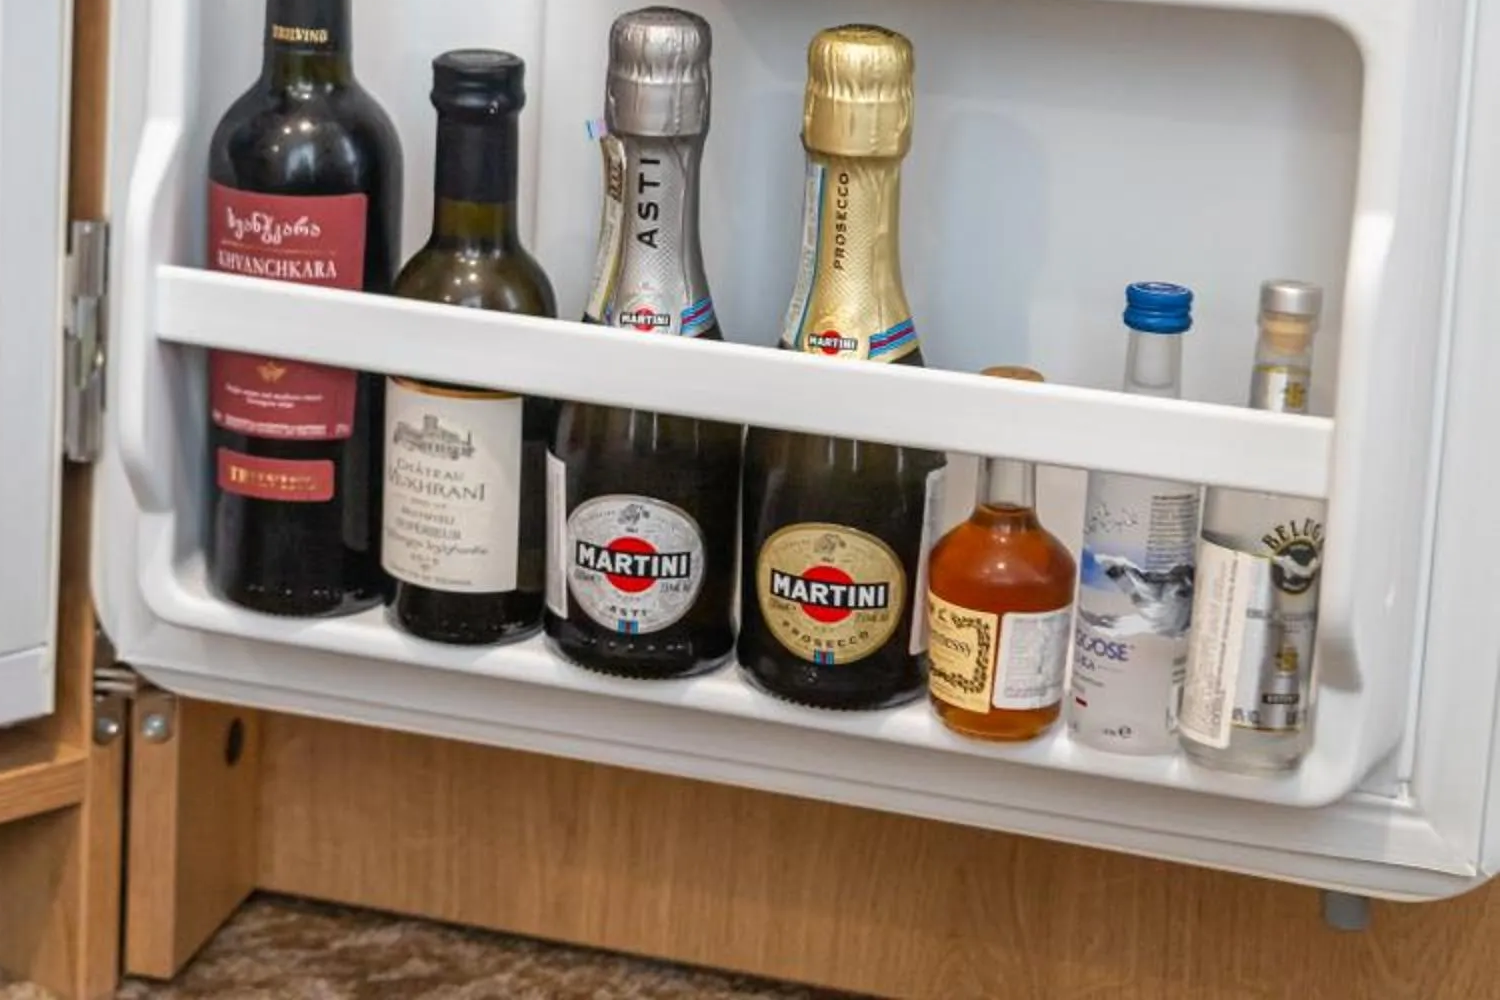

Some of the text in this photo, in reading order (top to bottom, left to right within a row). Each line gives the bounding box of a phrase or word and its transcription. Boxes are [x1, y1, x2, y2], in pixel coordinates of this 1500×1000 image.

[637, 158, 661, 249] ASTI
[833, 172, 850, 271] PROSECCO
[621, 313, 669, 326] MARTINI
[578, 543, 688, 577] MARTINI
[772, 572, 886, 608] MARTINI
